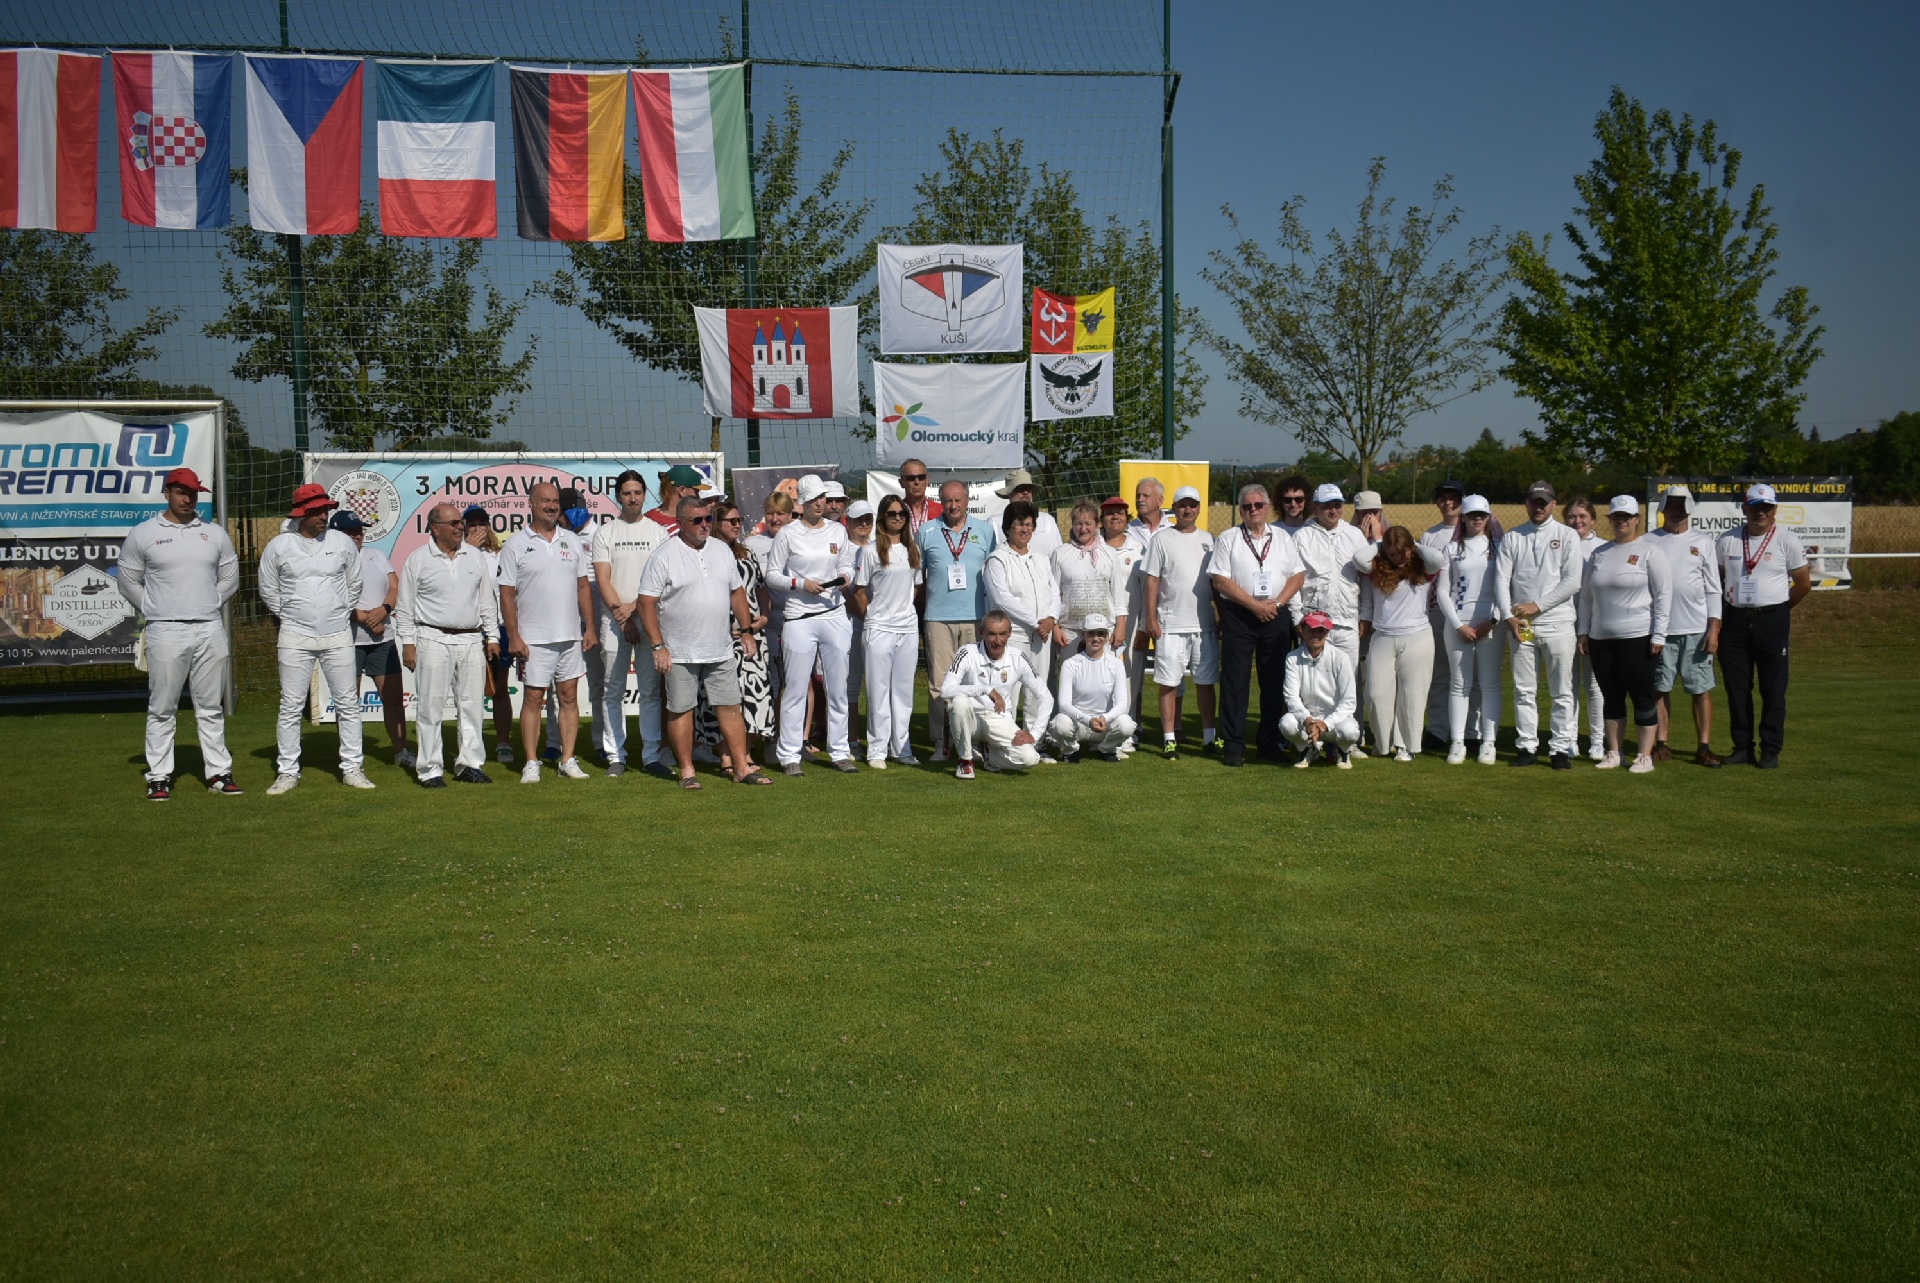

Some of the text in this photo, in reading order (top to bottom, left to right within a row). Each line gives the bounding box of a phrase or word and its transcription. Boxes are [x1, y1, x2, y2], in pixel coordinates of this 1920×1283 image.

[903, 253, 996, 270] ČESKÝ SVAZ
[941, 331, 968, 344] KUŠÍ
[911, 429, 1019, 444] Olomoucký kraj
[415, 475, 437, 496] 3.
[571, 475, 619, 496] CUP
[1813, 483, 1846, 493] KOTLE!
[513, 501, 525, 509] ve
[20, 511, 28, 520] A
[31, 509, 98, 520] INŽENÝRSKÉ
[101, 510, 140, 519] STAVBY
[84, 546, 100, 560] U
[51, 599, 127, 611] DISTILLERY
[77, 618, 104, 627] ŽEŠOV
[7, 649, 19, 658] 10
[21, 648, 33, 657] 15
